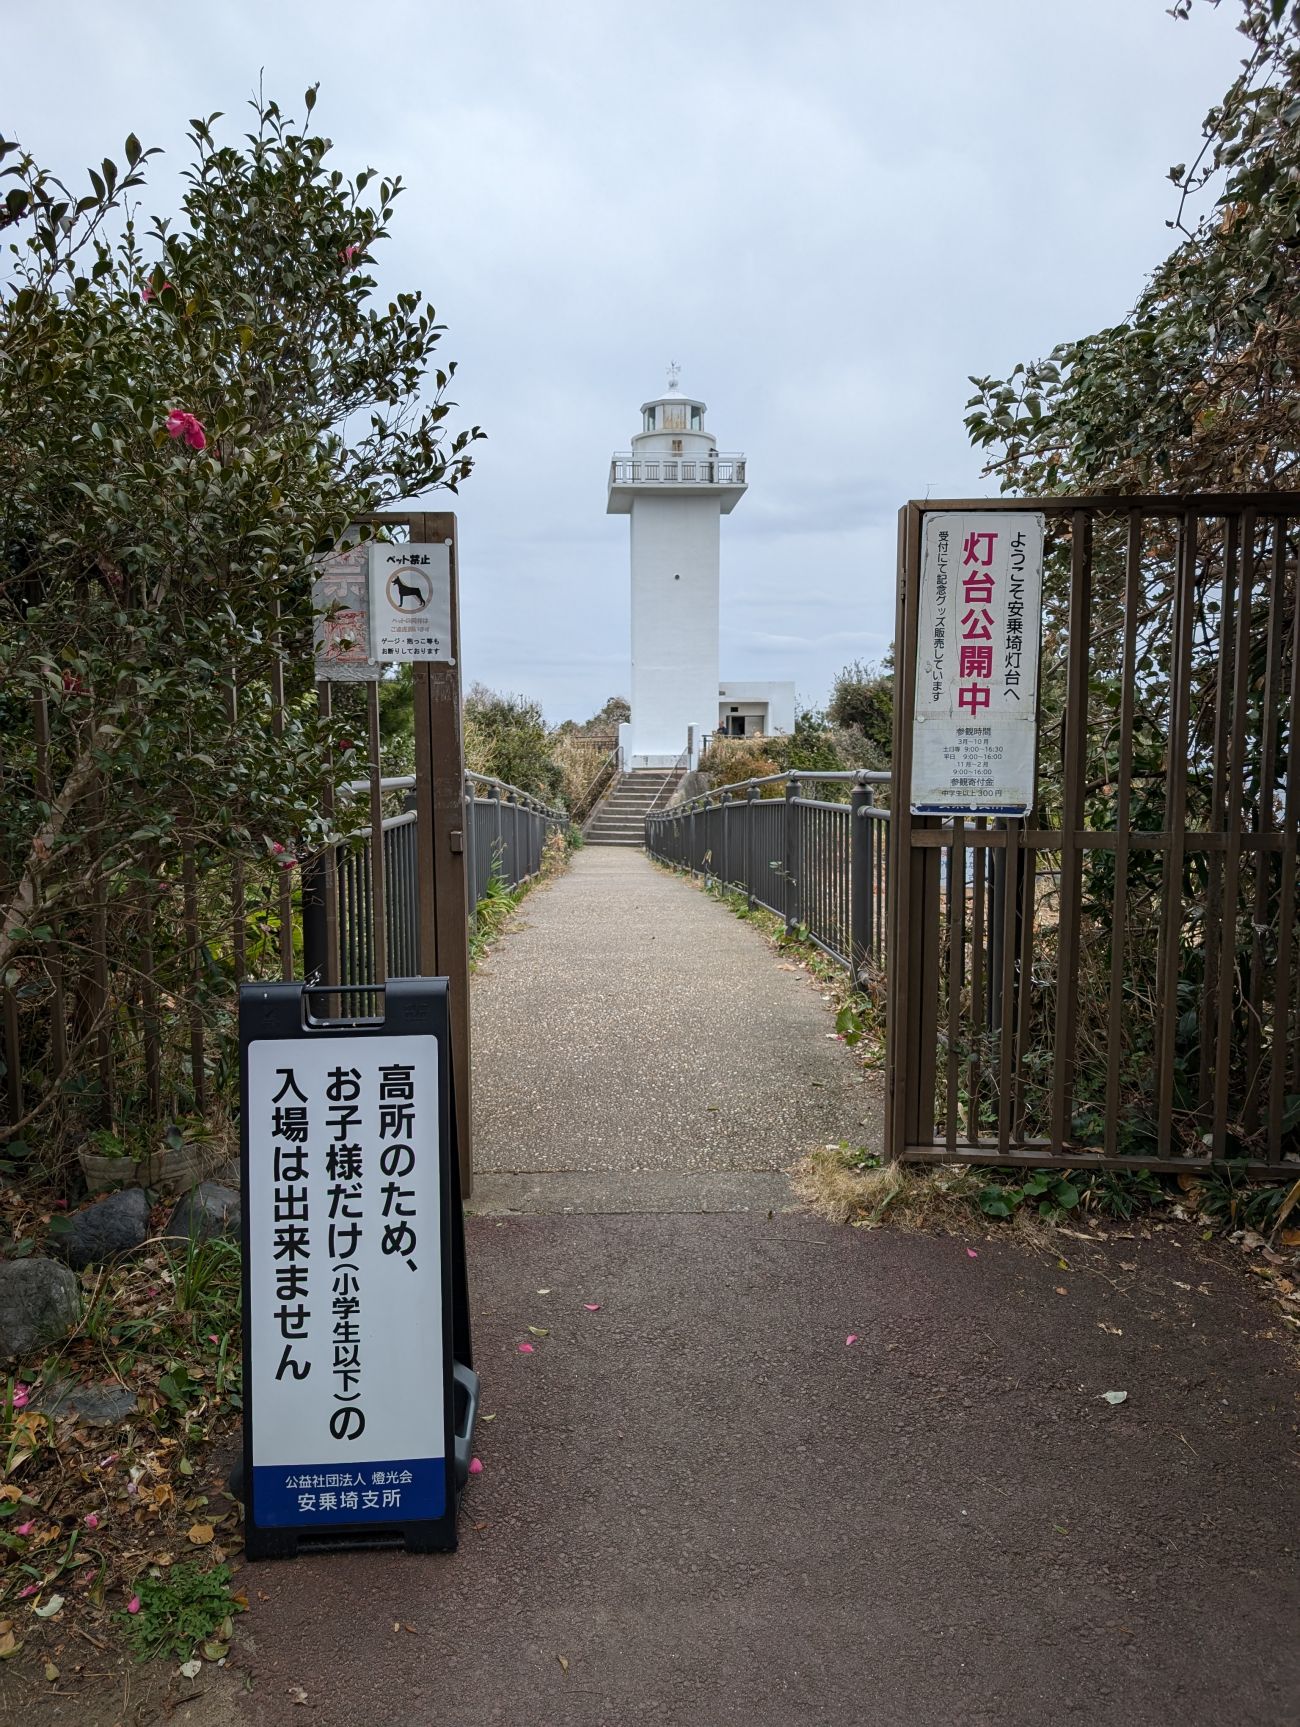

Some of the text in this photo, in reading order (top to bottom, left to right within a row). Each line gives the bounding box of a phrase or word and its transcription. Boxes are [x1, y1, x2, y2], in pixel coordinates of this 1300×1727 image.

[386, 554, 431, 565] ペット禁止
[931, 531, 949, 702] 受付にて記念グッズ販売しています
[957, 531, 999, 716] 灯台公開中
[1003, 531, 1027, 701] ようこそ安乗埼灯台へ
[382, 647, 440, 655] お断りしております
[956, 727, 991, 736] 参観時間
[951, 778, 995, 787] 参観寄付金
[378, 1063, 418, 1272] 高所のため、
[271, 1068, 312, 1380] 入場は出来ません
[285, 1470, 413, 1489] 公益社団法人 燈光会
[297, 1488, 402, 1512] 安乗埼支所
